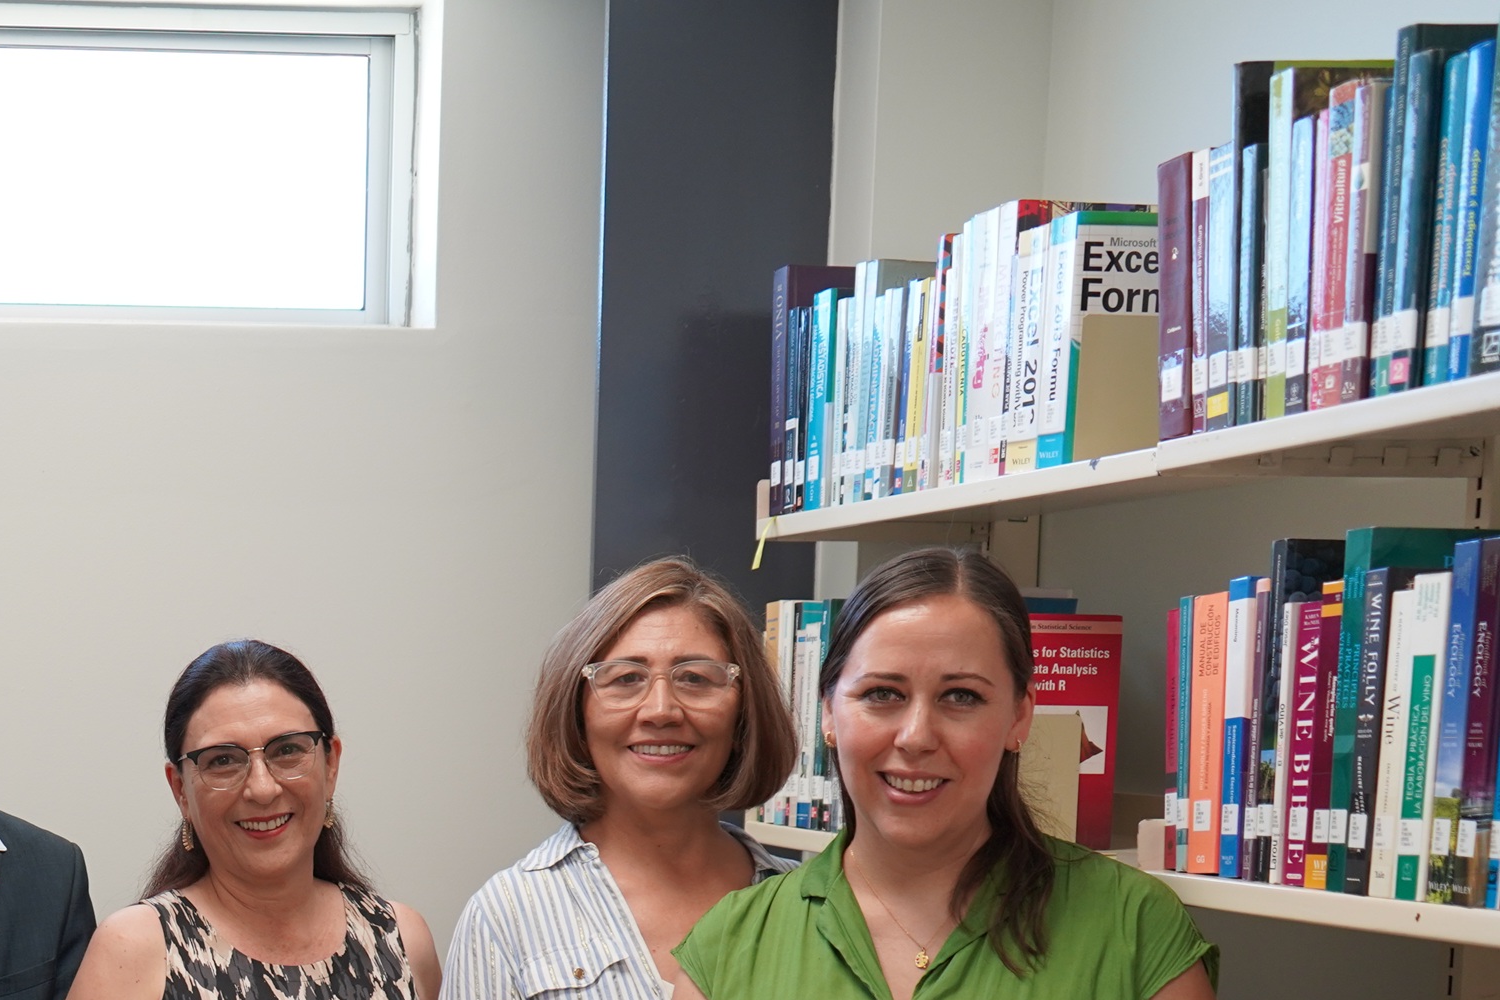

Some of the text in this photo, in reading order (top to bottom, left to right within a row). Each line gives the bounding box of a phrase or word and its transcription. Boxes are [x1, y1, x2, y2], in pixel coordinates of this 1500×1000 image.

[1333, 159, 1346, 224] Viticultura
[1083, 241, 1159, 274] Exce
[1109, 236, 1157, 248] Microsoft
[775, 295, 784, 341] VINO
[1028, 267, 1043, 347] Excel
[1048, 249, 1067, 402] Excel 2013 Formu
[1017, 305, 1027, 370] Programming
[816, 340, 828, 398] ESTADÍSTICA
[868, 339, 881, 442] ADMINISTRACIÓ
[1380, 369, 1388, 387] 1
[1392, 361, 1404, 379] 2
[1039, 451, 1059, 459] WILEY
[1041, 646, 1110, 659] for Statistics
[1198, 622, 1207, 677] MANUAL DE
[1206, 604, 1215, 676] CONSTRUCCIÓN
[1213, 614, 1221, 660] EDIFICIOS
[1364, 592, 1384, 707] WINE FOLLY
[1446, 623, 1462, 698] ENOLOGY
[1472, 621, 1488, 698] ENOLOGY
[1033, 663, 1098, 677] ata Analysis
[1058, 680, 1066, 691] R
[1342, 648, 1351, 708] PRACTICES
[1350, 644, 1361, 708] PRINCIPLES
[1384, 695, 1401, 745] Wine
[1407, 704, 1421, 753] PRÁCTICA
[1413, 675, 1433, 814] LA ELABORACIÓN DEL VINO
[1287, 641, 1320, 864] WINE BIBE
[1404, 765, 1417, 801] TEORÍA
[1270, 839, 1278, 871] Larou
[1428, 881, 1449, 891] WILEY
[1453, 884, 1472, 894] WILEY
